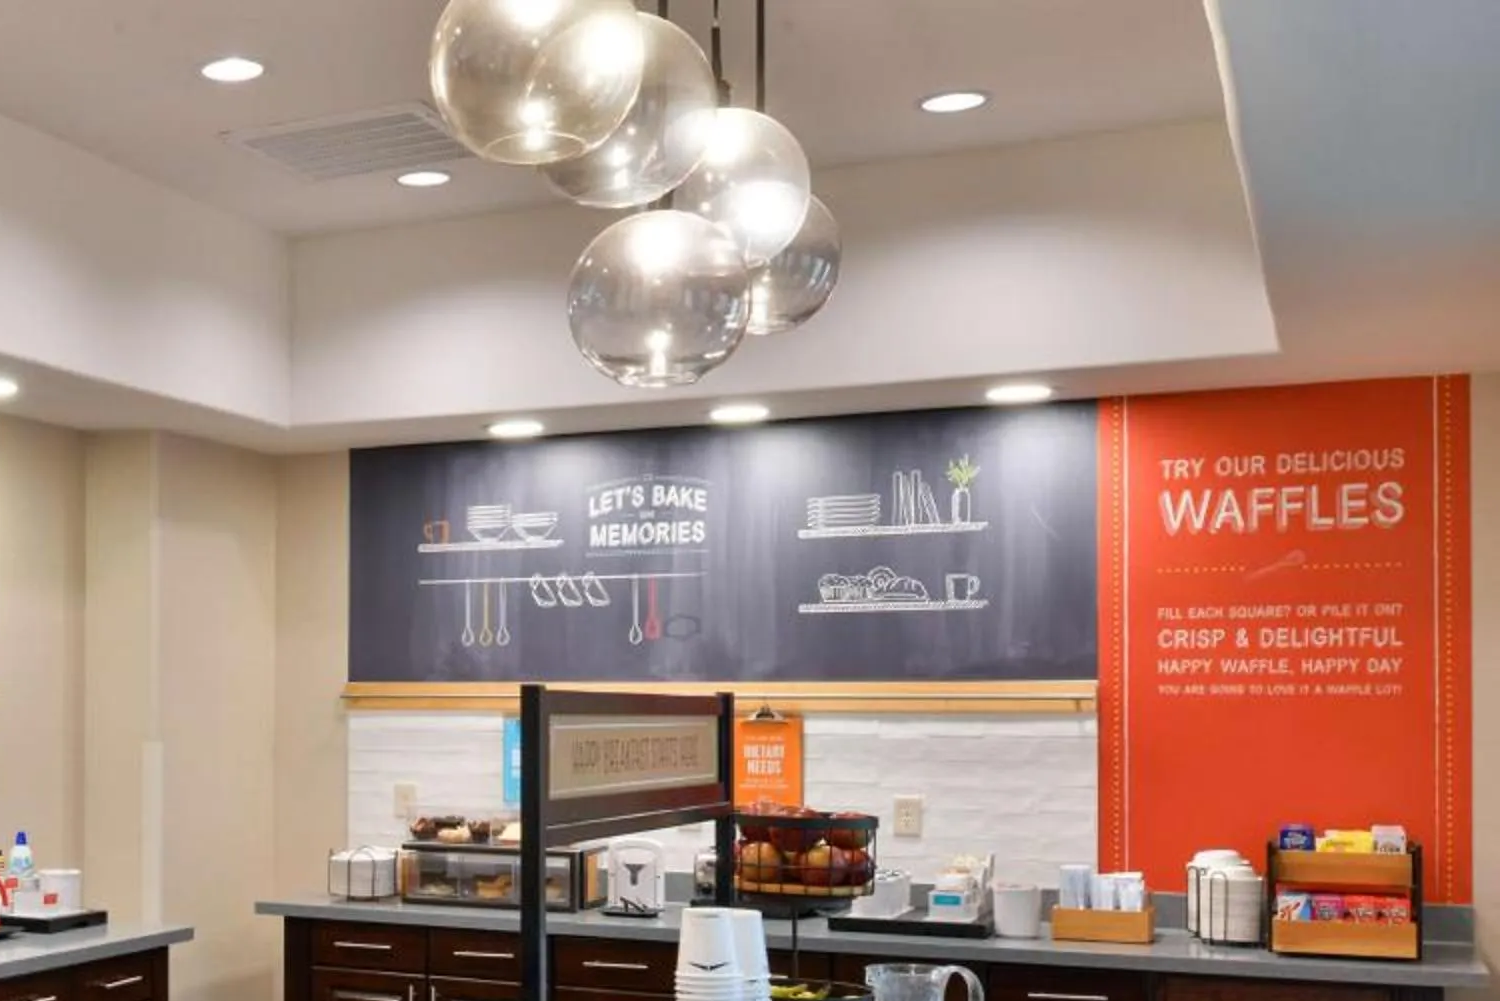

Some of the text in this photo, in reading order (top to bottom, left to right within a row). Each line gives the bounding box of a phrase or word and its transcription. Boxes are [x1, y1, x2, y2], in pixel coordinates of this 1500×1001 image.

[1160, 447, 1406, 481] TRY OUR DELICIOUS
[588, 484, 708, 519] LET'S BAKE
[1160, 481, 1407, 537] WAFFLES
[589, 521, 706, 547] MEMORIES
[1157, 607, 1182, 620] FILL
[1188, 606, 1223, 620] EACH
[1229, 605, 1291, 619] SQUARE?
[1296, 604, 1316, 617] OR
[1157, 626, 1403, 649] CRISP & DELIGHTFUL
[1157, 657, 1403, 676] HAPPY WAFFLE, HAPPY DAY
[1158, 684, 1181, 696] YOU
[1185, 684, 1205, 696] ARE
[1267, 684, 1296, 695] LOVE
[747, 759, 783, 776] NEEDS
